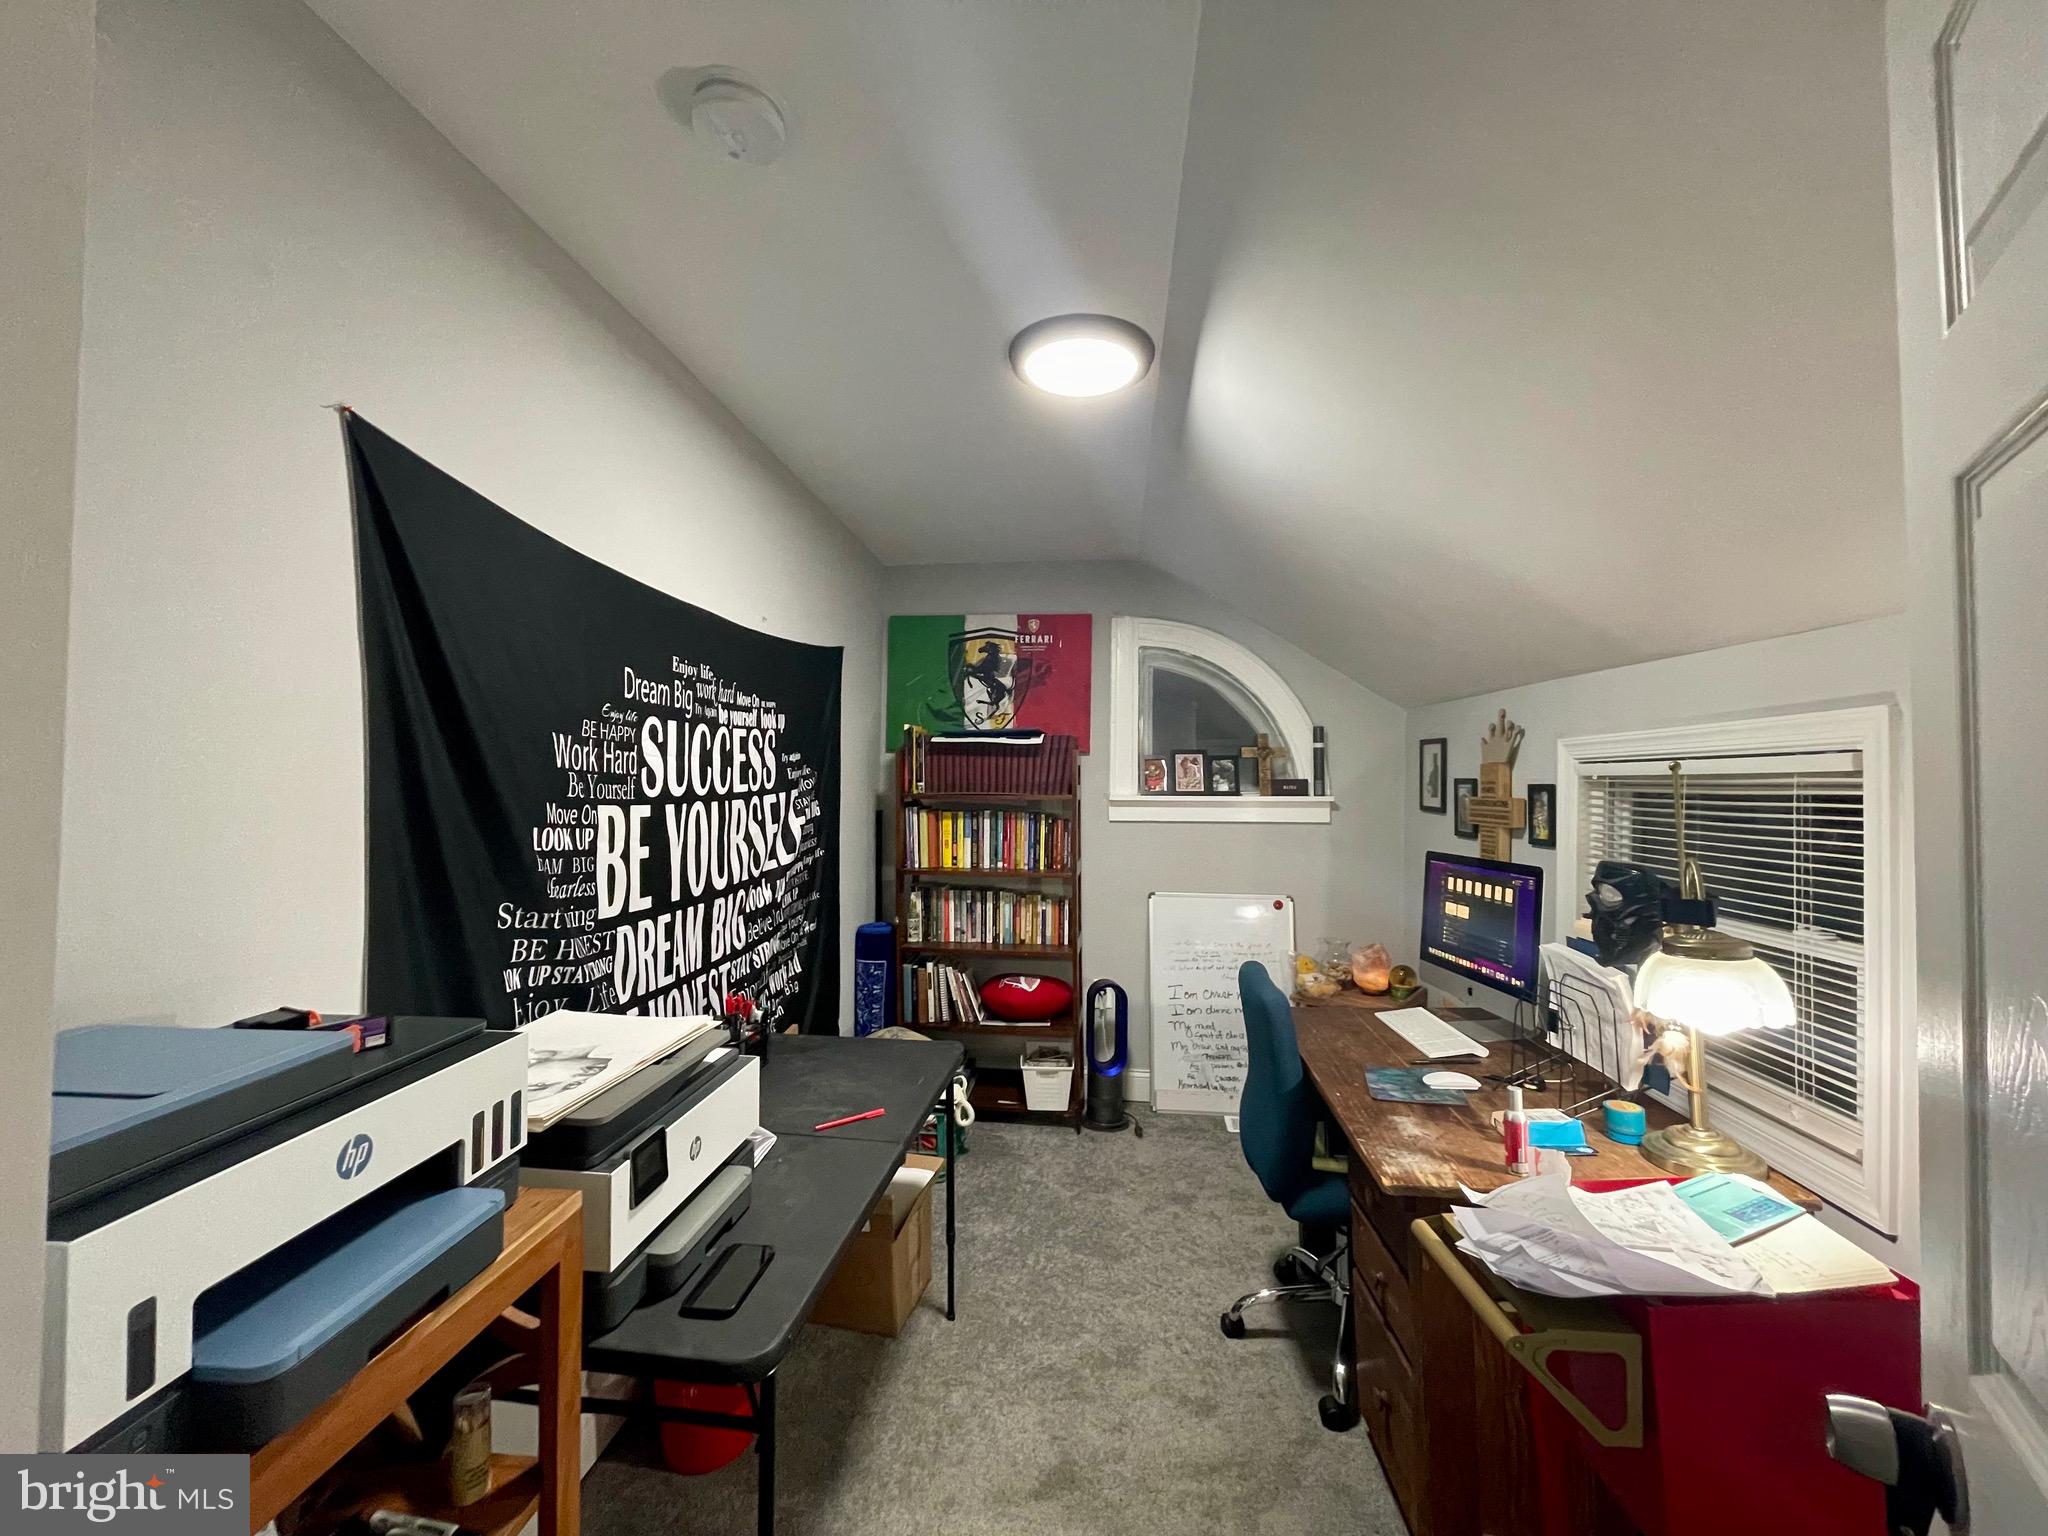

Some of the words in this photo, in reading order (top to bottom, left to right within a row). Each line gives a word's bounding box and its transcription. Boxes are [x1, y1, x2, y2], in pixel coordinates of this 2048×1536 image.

[1014, 634, 1054, 644] FERRARI
[672, 655, 698, 680] Enjoy
[624, 666, 670, 707] Dream
[674, 679, 693, 719] Big
[582, 719, 598, 738] BE
[600, 722, 636, 743] HAPPY
[760, 708, 776, 729] look
[552, 731, 598, 772] Work
[603, 740, 638, 775] Hard
[641, 716, 776, 798] SUCCESS
[567, 772, 585, 798] Be
[587, 774, 637, 800] Yourself
[546, 802, 578, 824] Move
[582, 804, 598, 825] On
[533, 827, 573, 851] LOOK
[575, 828, 595, 851] UP
[572, 856, 595, 874] BIG
[596, 804, 652, 919] BE
[511, 938, 548, 963] BE
[613, 901, 705, 1006] DREAM
[710, 889, 746, 964] BIG
[528, 965, 552, 987] UP
[730, 951, 752, 983] STAY
[338, 1135, 371, 1180] hp
